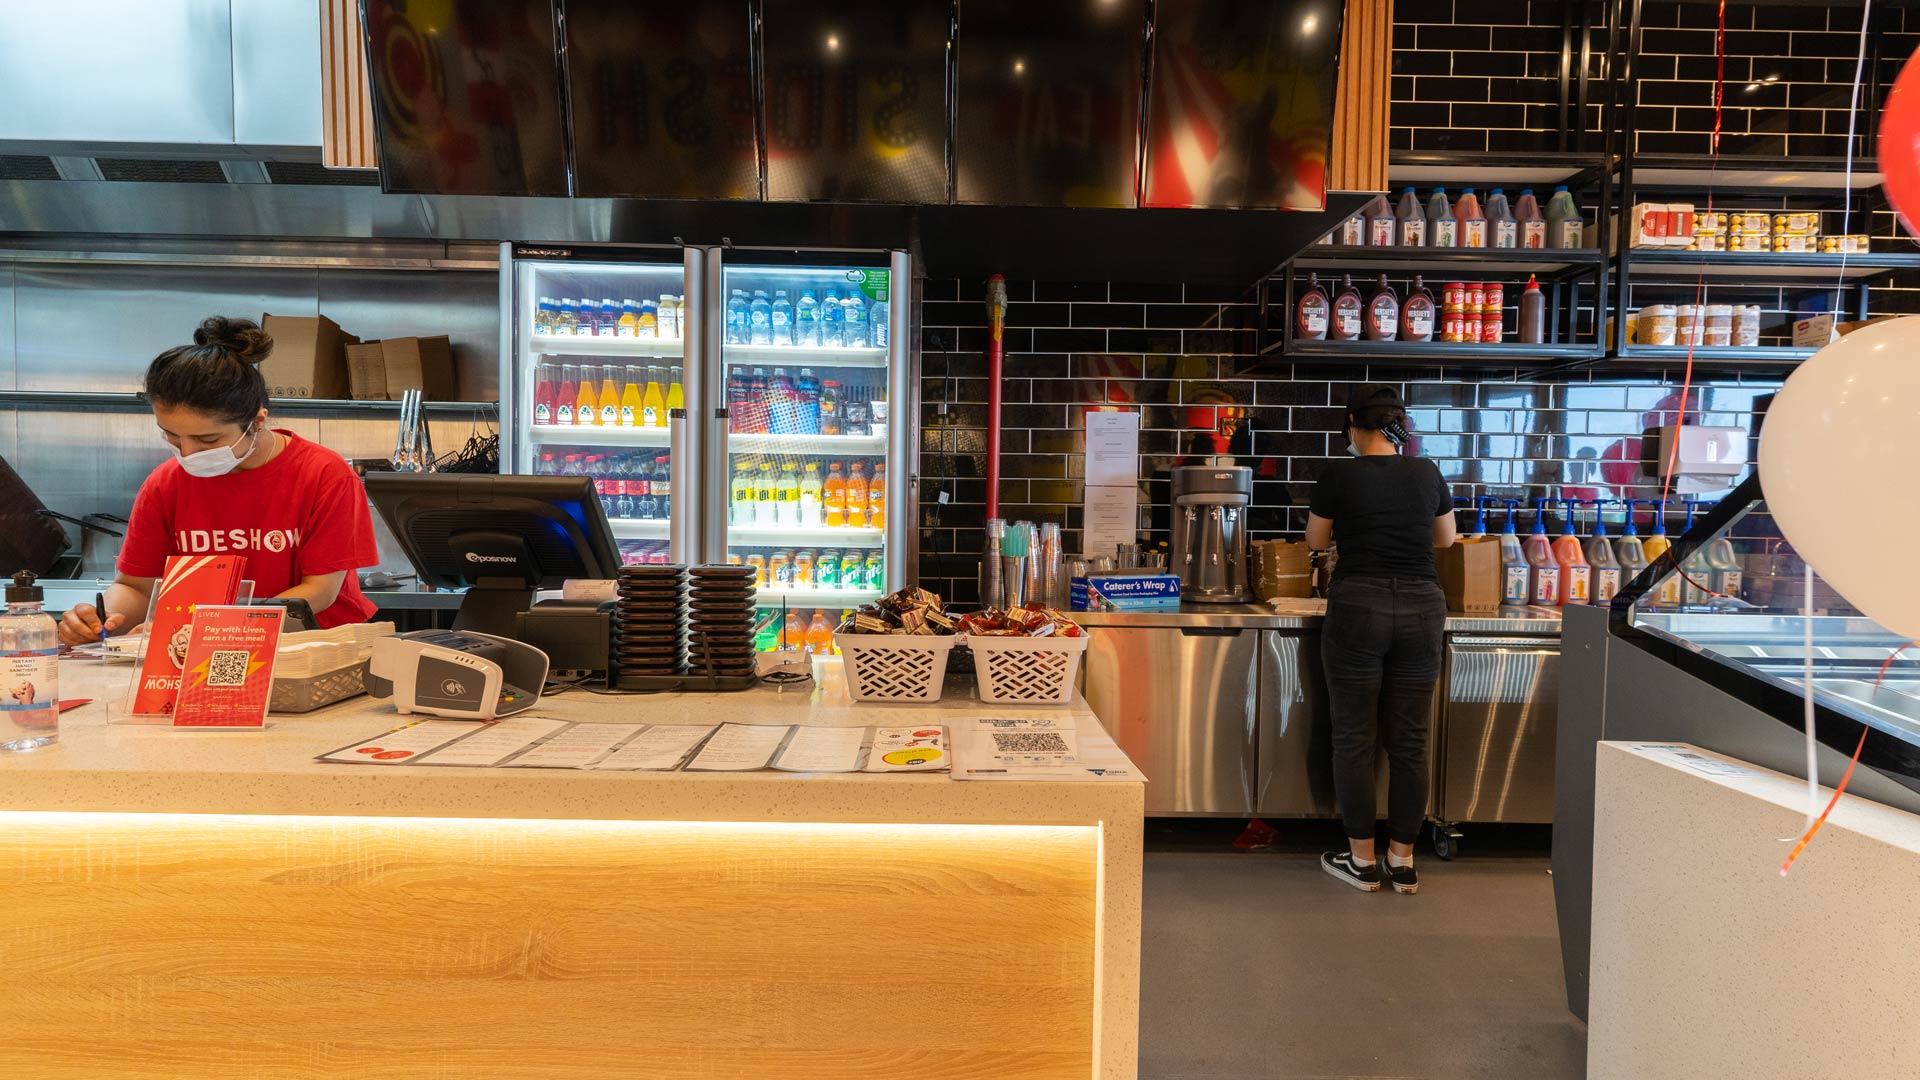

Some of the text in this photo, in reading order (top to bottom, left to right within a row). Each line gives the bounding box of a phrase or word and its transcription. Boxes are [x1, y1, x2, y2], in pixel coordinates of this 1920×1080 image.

[175, 527, 303, 553] IDESHOW
[1103, 581, 1166, 592] Caterer's Wrap
[205, 625, 267, 635] Pay with Liven,
[229, 634, 245, 642] free
[246, 634, 266, 642] meal!
